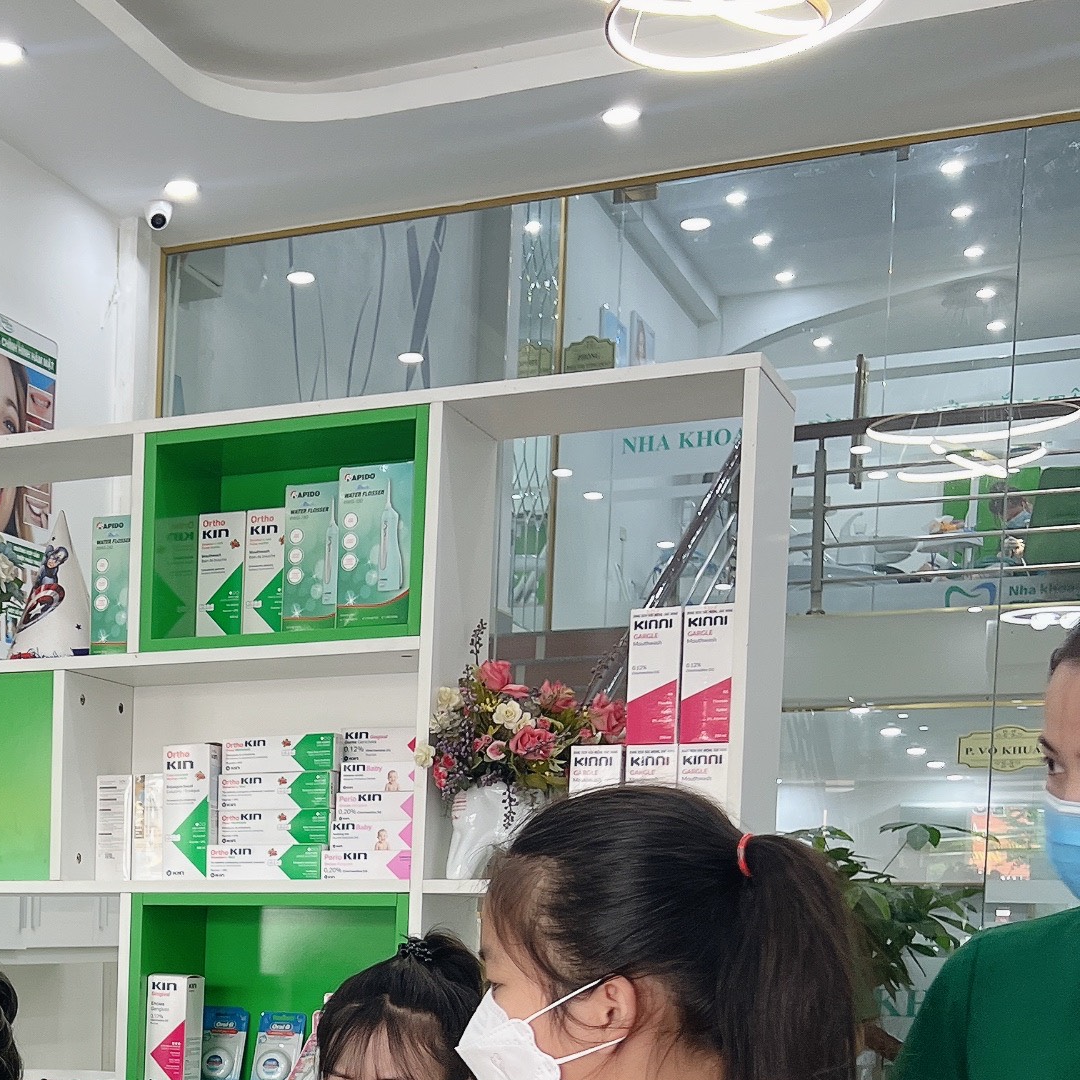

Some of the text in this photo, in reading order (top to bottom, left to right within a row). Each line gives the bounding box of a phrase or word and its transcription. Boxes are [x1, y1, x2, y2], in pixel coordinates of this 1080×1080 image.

[622, 434, 670, 454] NHA
[344, 473, 376, 482] RAPIDO
[290, 490, 321, 499] RAPIDO
[202, 519, 226, 528] Ortho
[250, 515, 275, 524] Ortho
[1009, 585, 1037, 597] Nha
[633, 618, 673, 630] KINNI
[687, 615, 728, 627] KINNI
[166, 750, 190, 759] Ortho
[682, 754, 723, 766] KINNI
[151, 981, 177, 991] KIN
